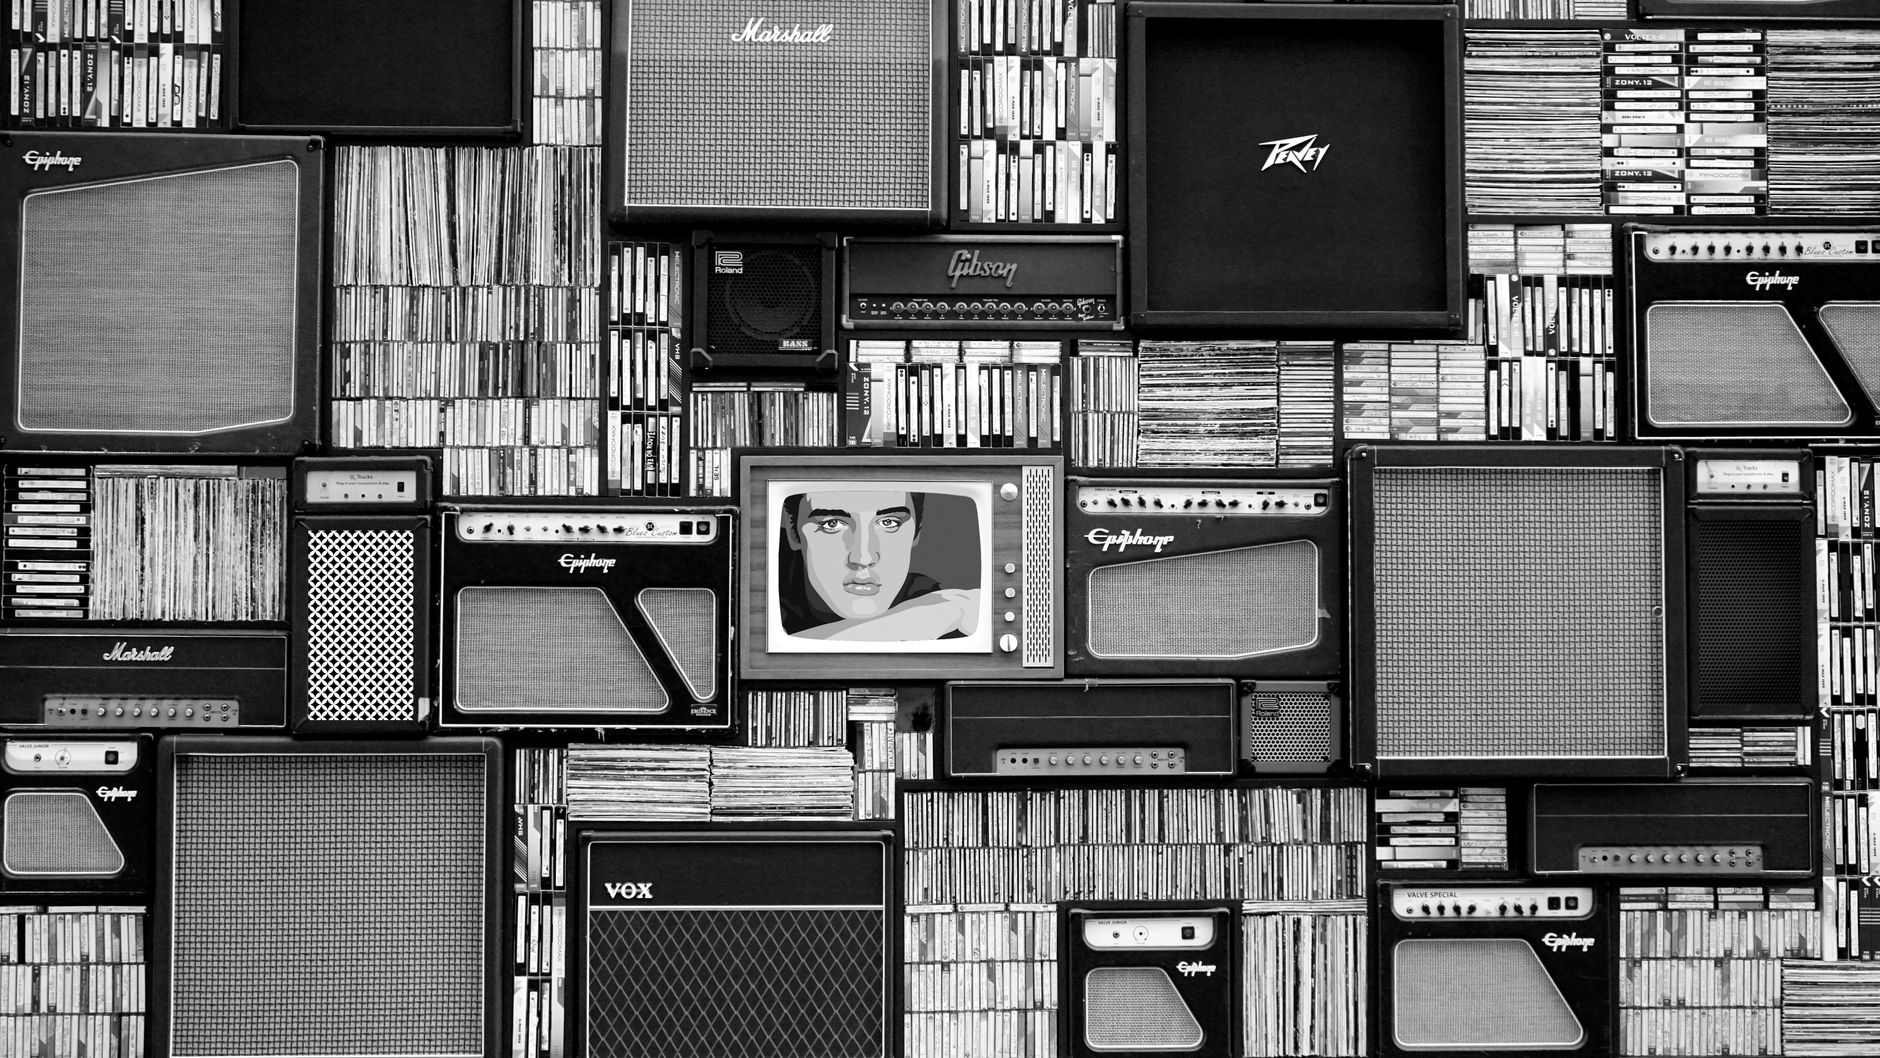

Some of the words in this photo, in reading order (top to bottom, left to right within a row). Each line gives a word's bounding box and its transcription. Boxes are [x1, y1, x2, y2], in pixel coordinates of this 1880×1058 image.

[731, 17, 833, 42] Marshall
[22, 150, 82, 171] Epiphone
[1258, 134, 1330, 173] PEAVEY
[715, 266, 743, 274] Roland
[947, 250, 1018, 288] Gibson
[1745, 270, 1800, 291] Epiphone
[782, 339, 810, 348] BASS
[1084, 528, 1175, 553] Epiphone
[558, 553, 616, 574] Epiphone
[103, 641, 175, 662] Marshall
[96, 786, 138, 802] Epiphone
[604, 882, 653, 899] VOX
[1407, 891, 1428, 899] VALVE
[1429, 891, 1457, 899] SPECIAL
[1542, 932, 1595, 952] Epiphone
[1176, 961, 1217, 977] Epiphone
